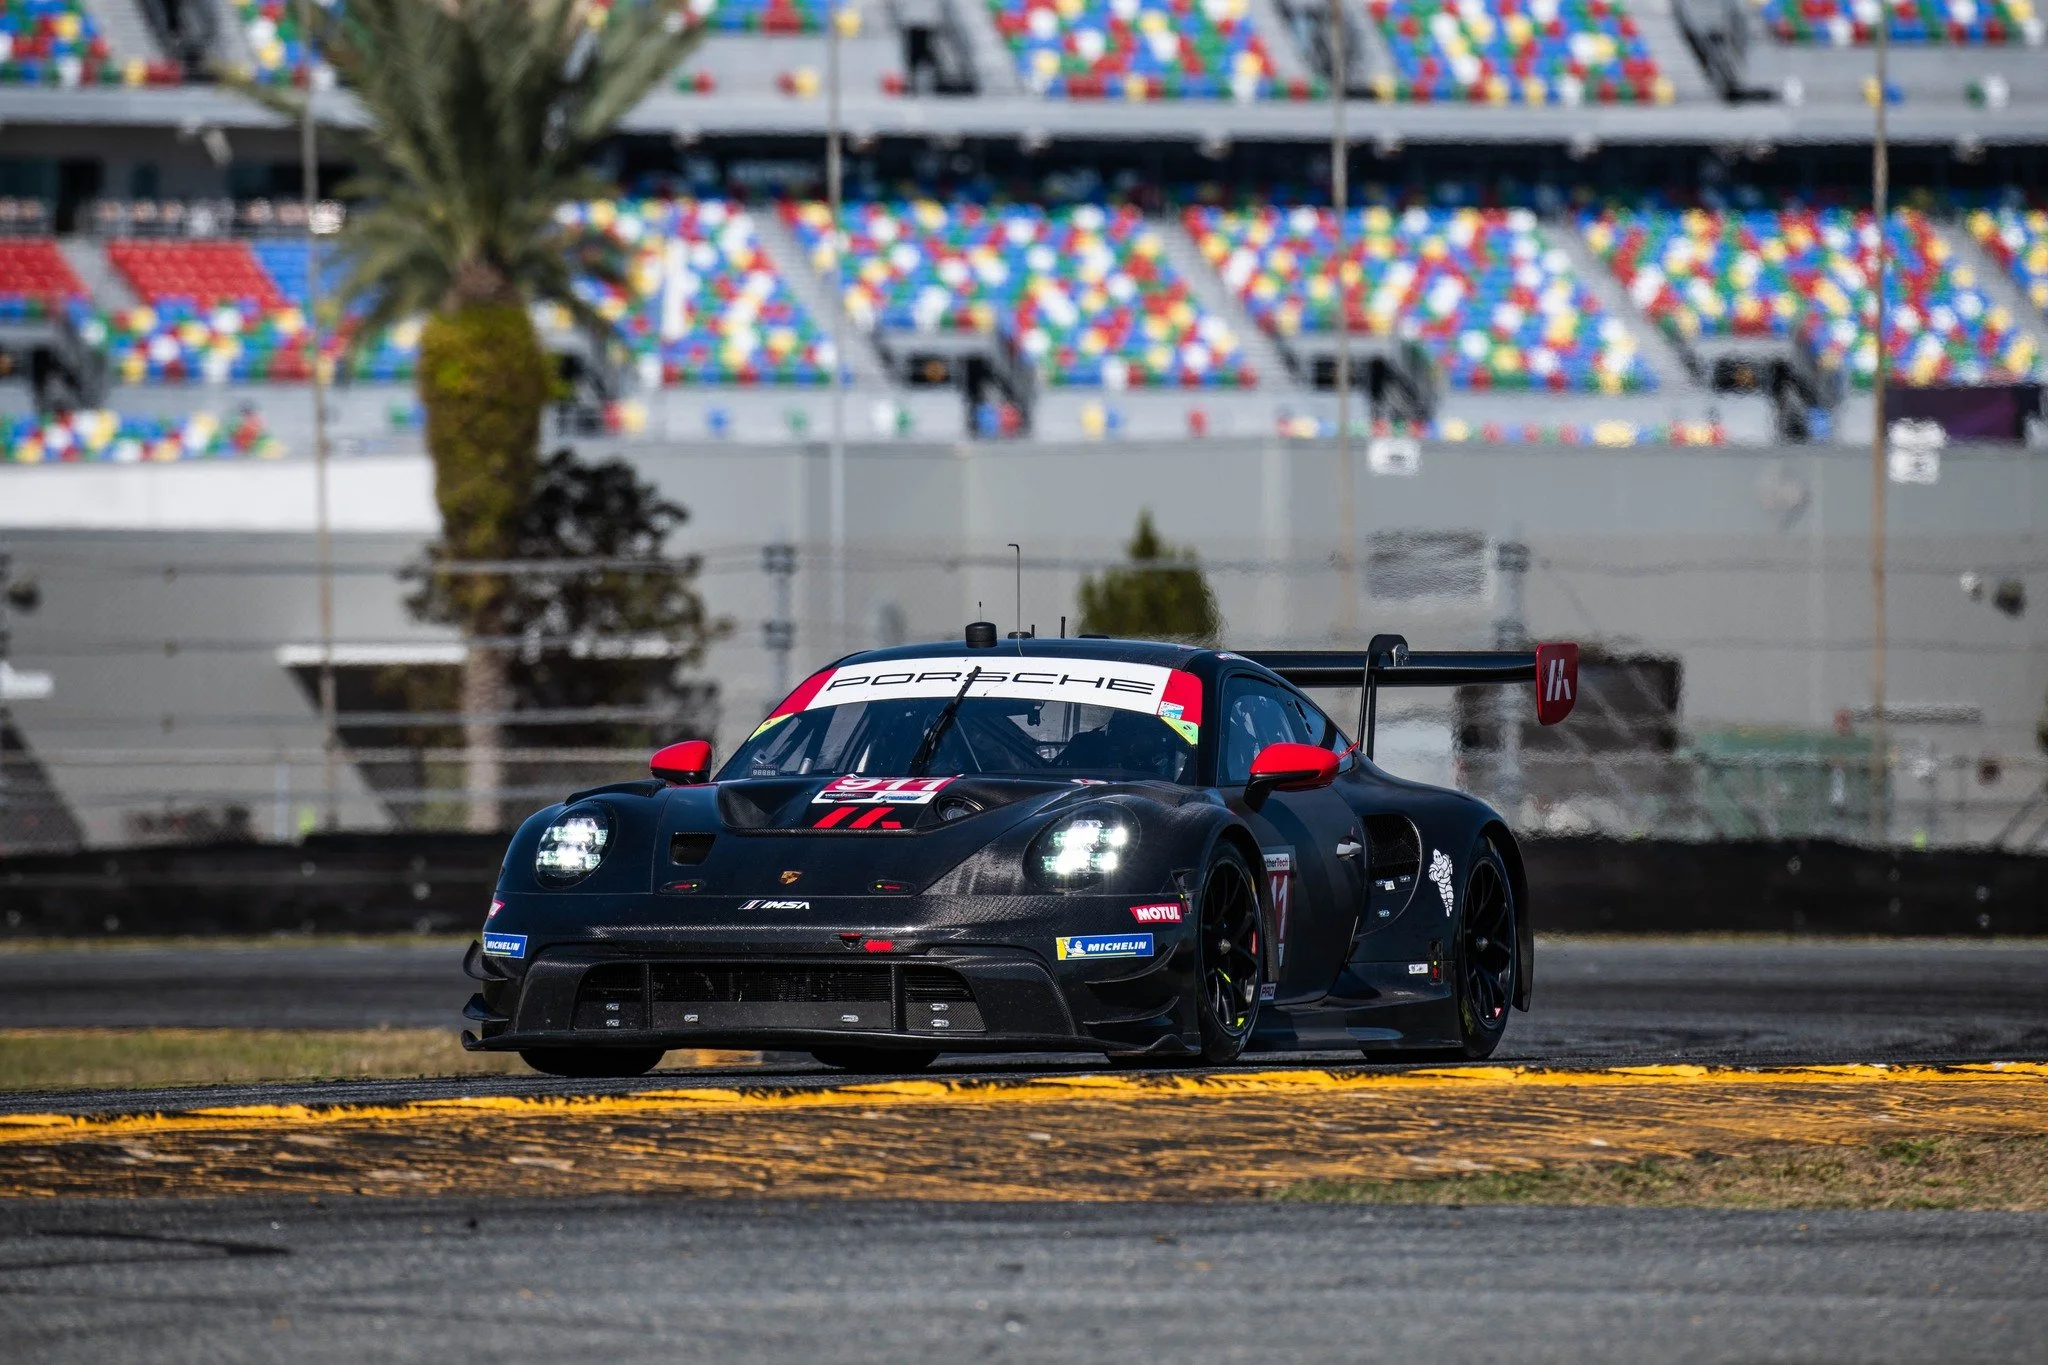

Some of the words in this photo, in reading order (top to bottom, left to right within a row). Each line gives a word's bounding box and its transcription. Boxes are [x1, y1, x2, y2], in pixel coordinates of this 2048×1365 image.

[826, 671, 1156, 696] PORSCHE
[835, 776, 951, 790] 911
[760, 901, 810, 910] IMSA
[1136, 905, 1181, 921] MOTUL
[486, 940, 521, 951] MICHELIN
[1087, 941, 1147, 952] MICHELIN
